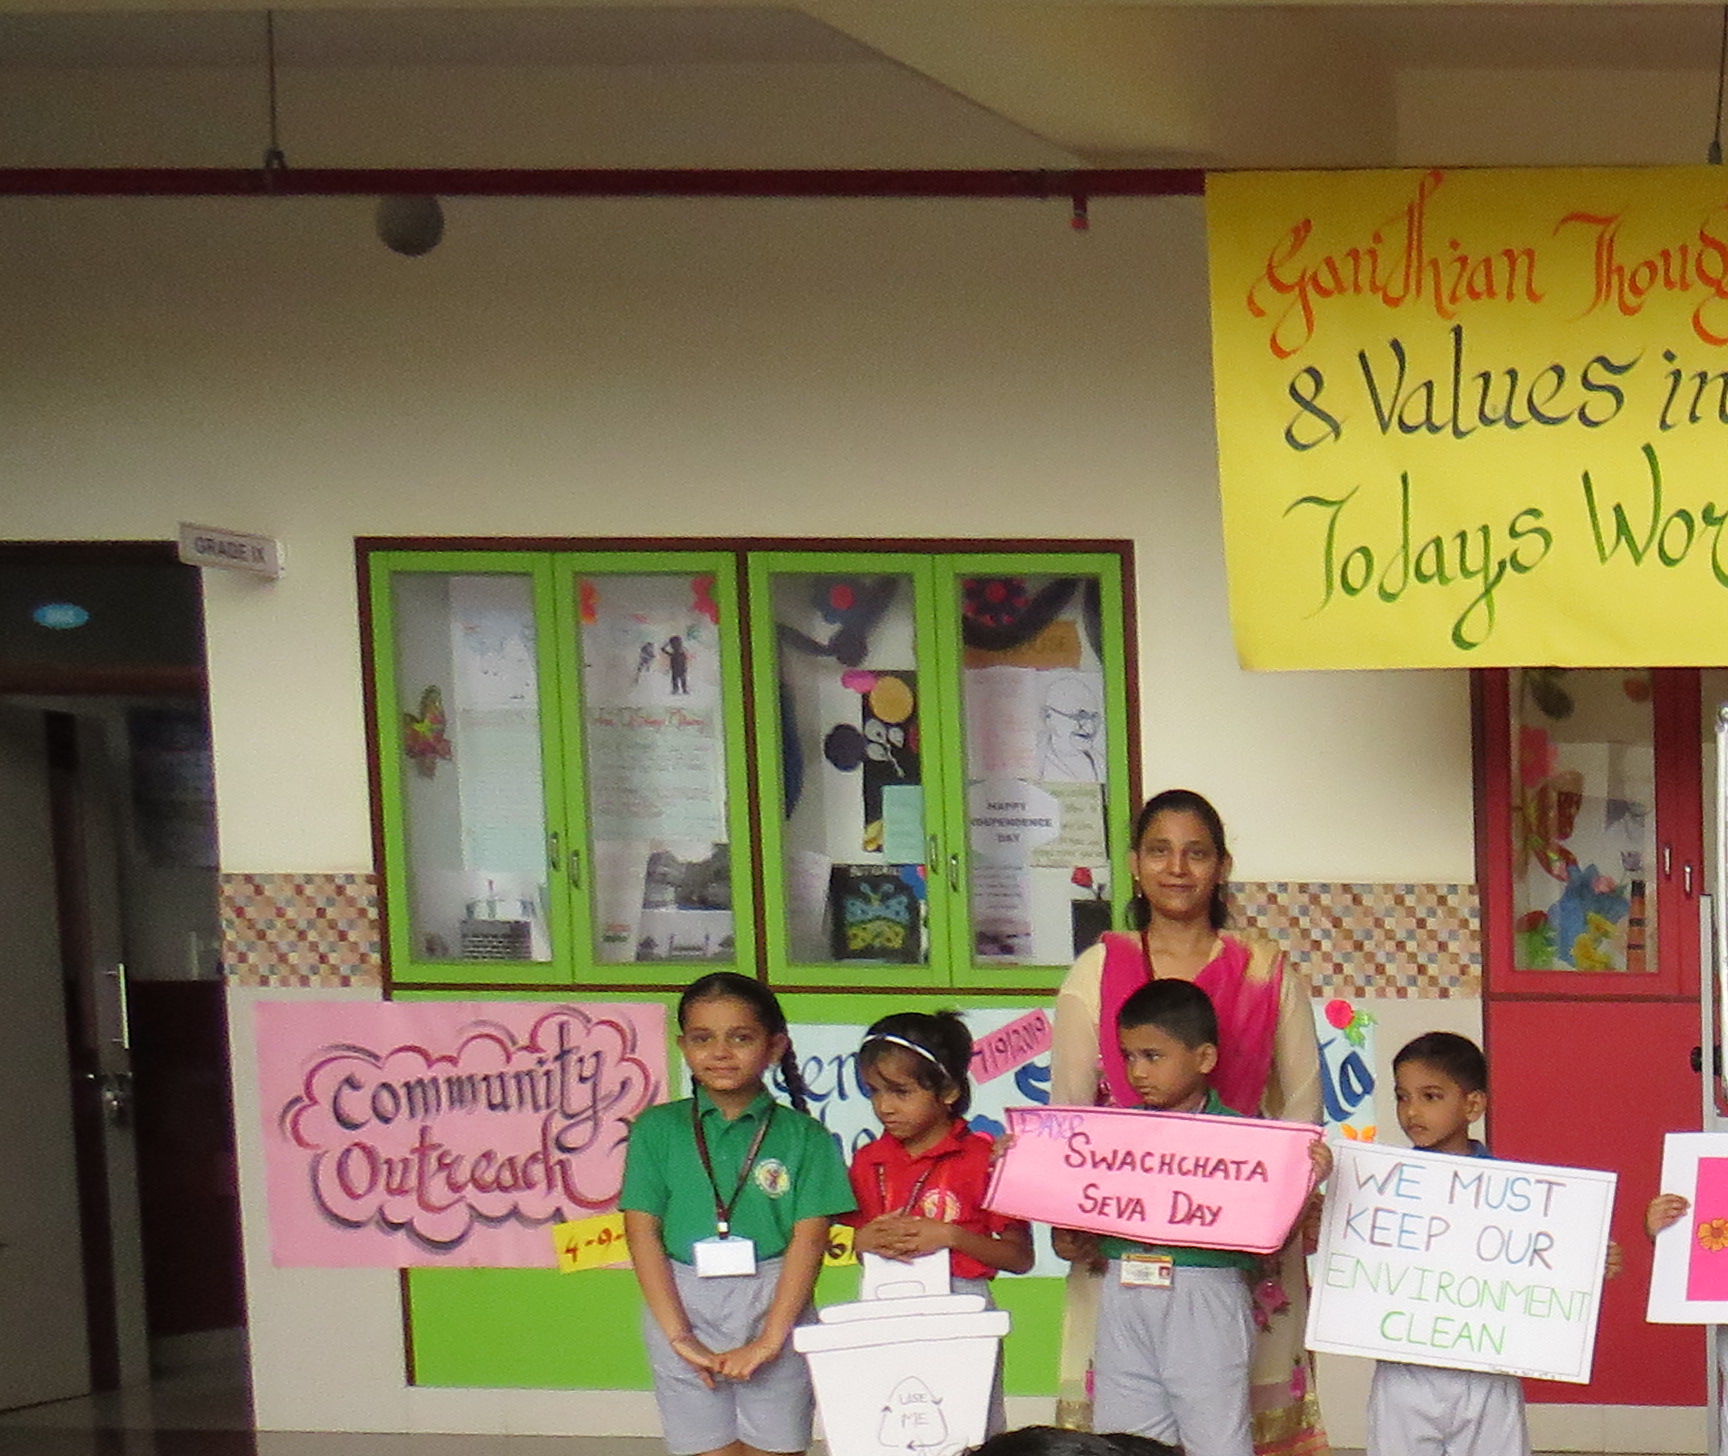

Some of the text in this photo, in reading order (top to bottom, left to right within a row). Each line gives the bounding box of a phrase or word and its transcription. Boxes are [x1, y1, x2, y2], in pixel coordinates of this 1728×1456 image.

[1358, 324, 1647, 439] Values
[332, 1020, 632, 1153] Community
[336, 1112, 622, 1214] Outreach
[1064, 1131, 1269, 1183] SWACHCHATA
[1353, 1156, 1567, 1218] WE MUST
[1077, 1183, 1224, 1227] SEVA DAY
[1342, 1203, 1555, 1271] KEEP OUR
[1325, 1252, 1591, 1322] ENVIRONMENT
[1380, 1310, 1507, 1354] CLEAN
